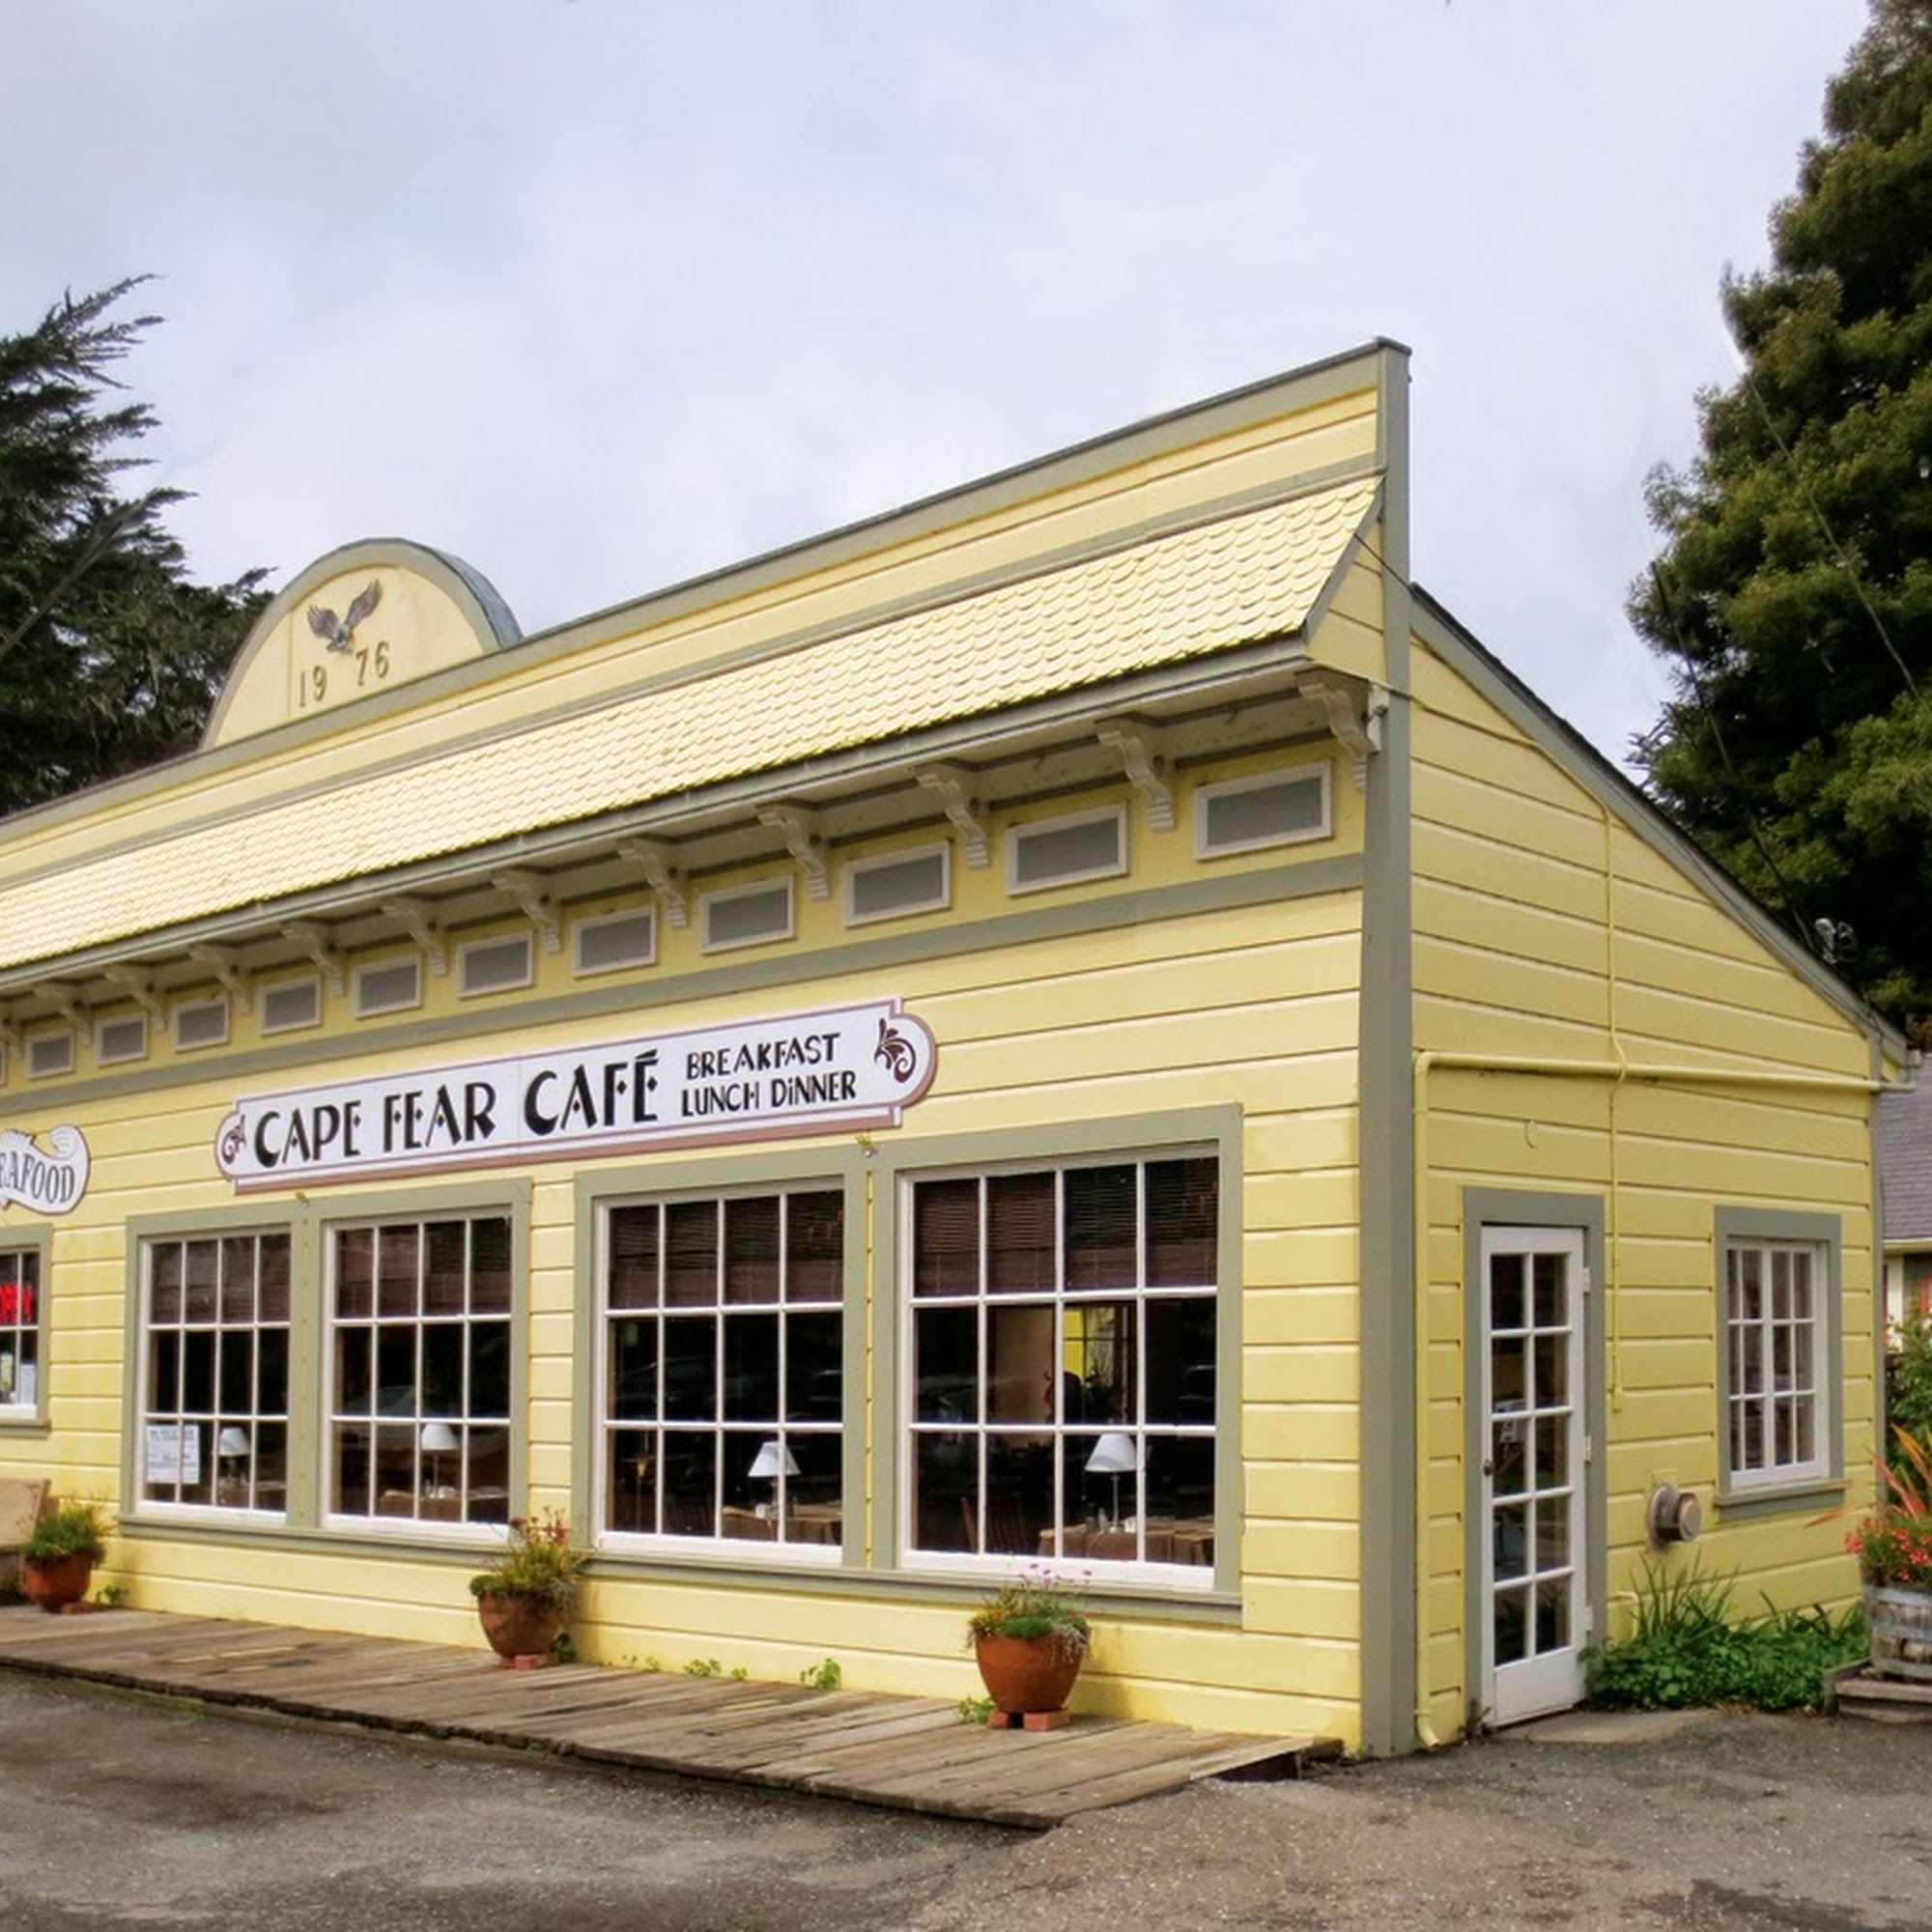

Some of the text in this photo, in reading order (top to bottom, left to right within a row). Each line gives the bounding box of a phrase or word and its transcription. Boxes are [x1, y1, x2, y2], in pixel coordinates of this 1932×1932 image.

[687, 1032, 840, 1080] BREAKFAST
[254, 1048, 660, 1168] CAPE FEAR CAFÉ
[682, 1081, 760, 1117] LUNCH
